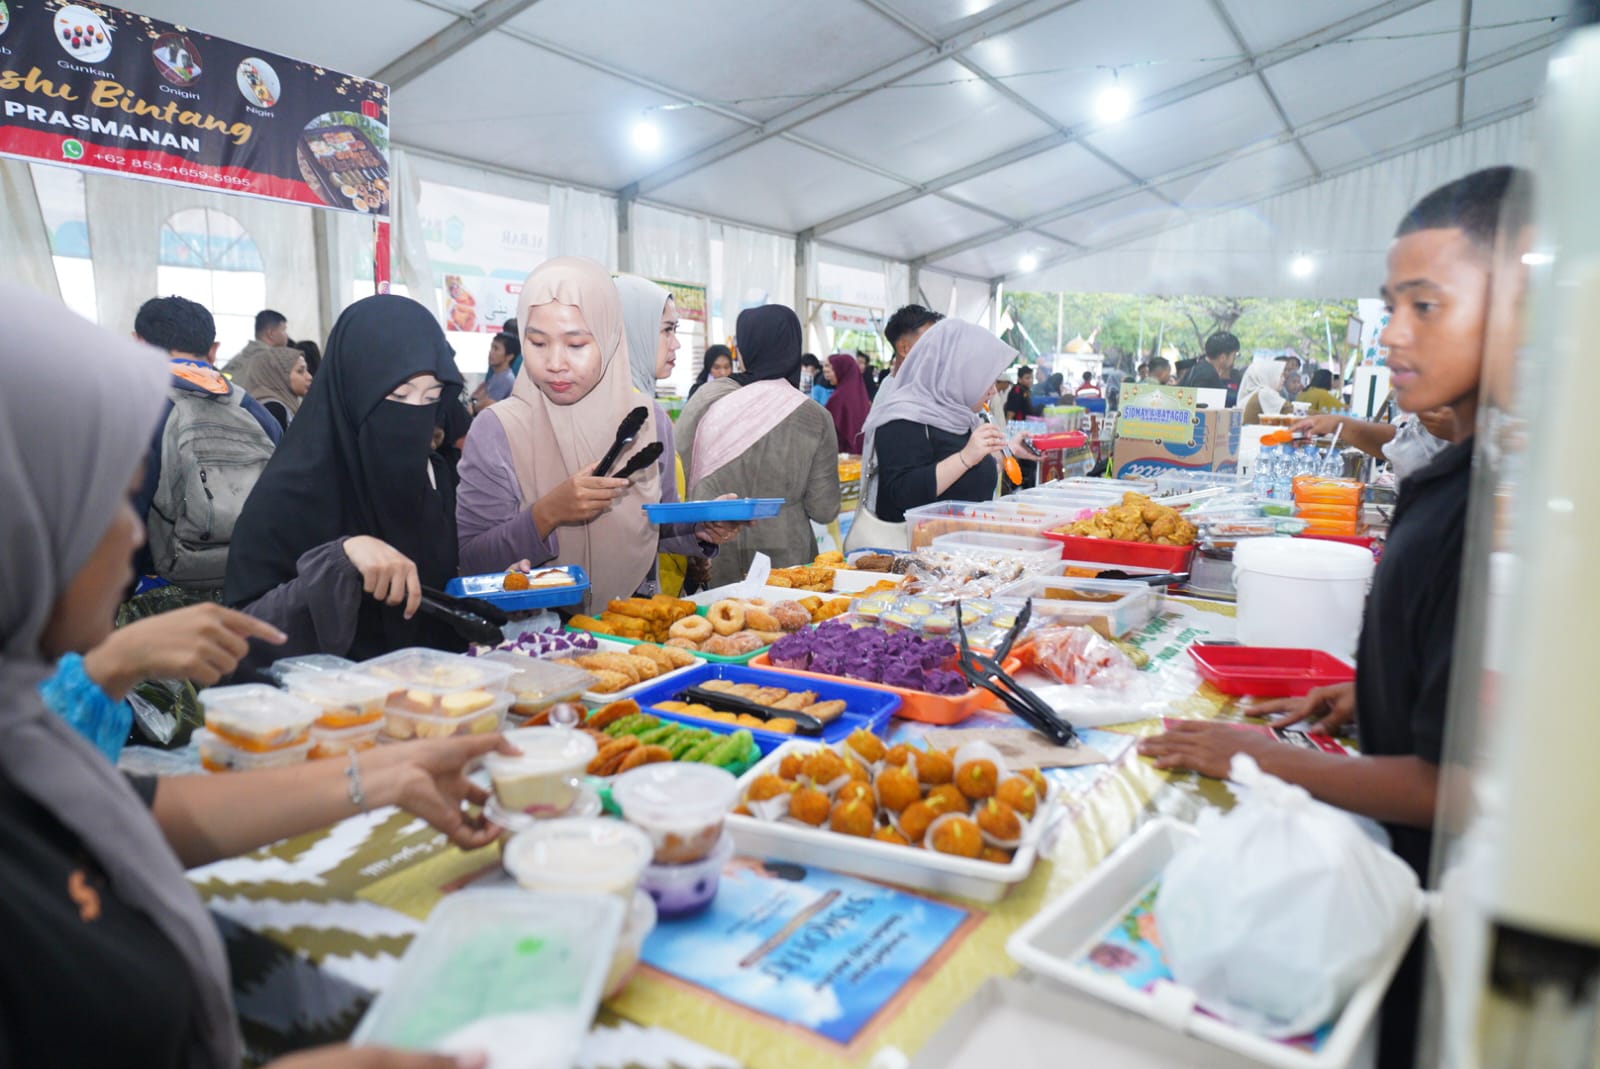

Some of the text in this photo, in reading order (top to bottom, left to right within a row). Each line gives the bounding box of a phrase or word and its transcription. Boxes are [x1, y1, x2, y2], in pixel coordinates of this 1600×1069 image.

[57, 60, 115, 80] Gunkan
[159, 84, 200, 101] Onigiri
[91, 79, 252, 145] Bintang
[245, 105, 275, 119] Nigiri
[4, 100, 200, 153] PRASMANAN
[93, 153, 250, 187] +62 853-4659-5995
